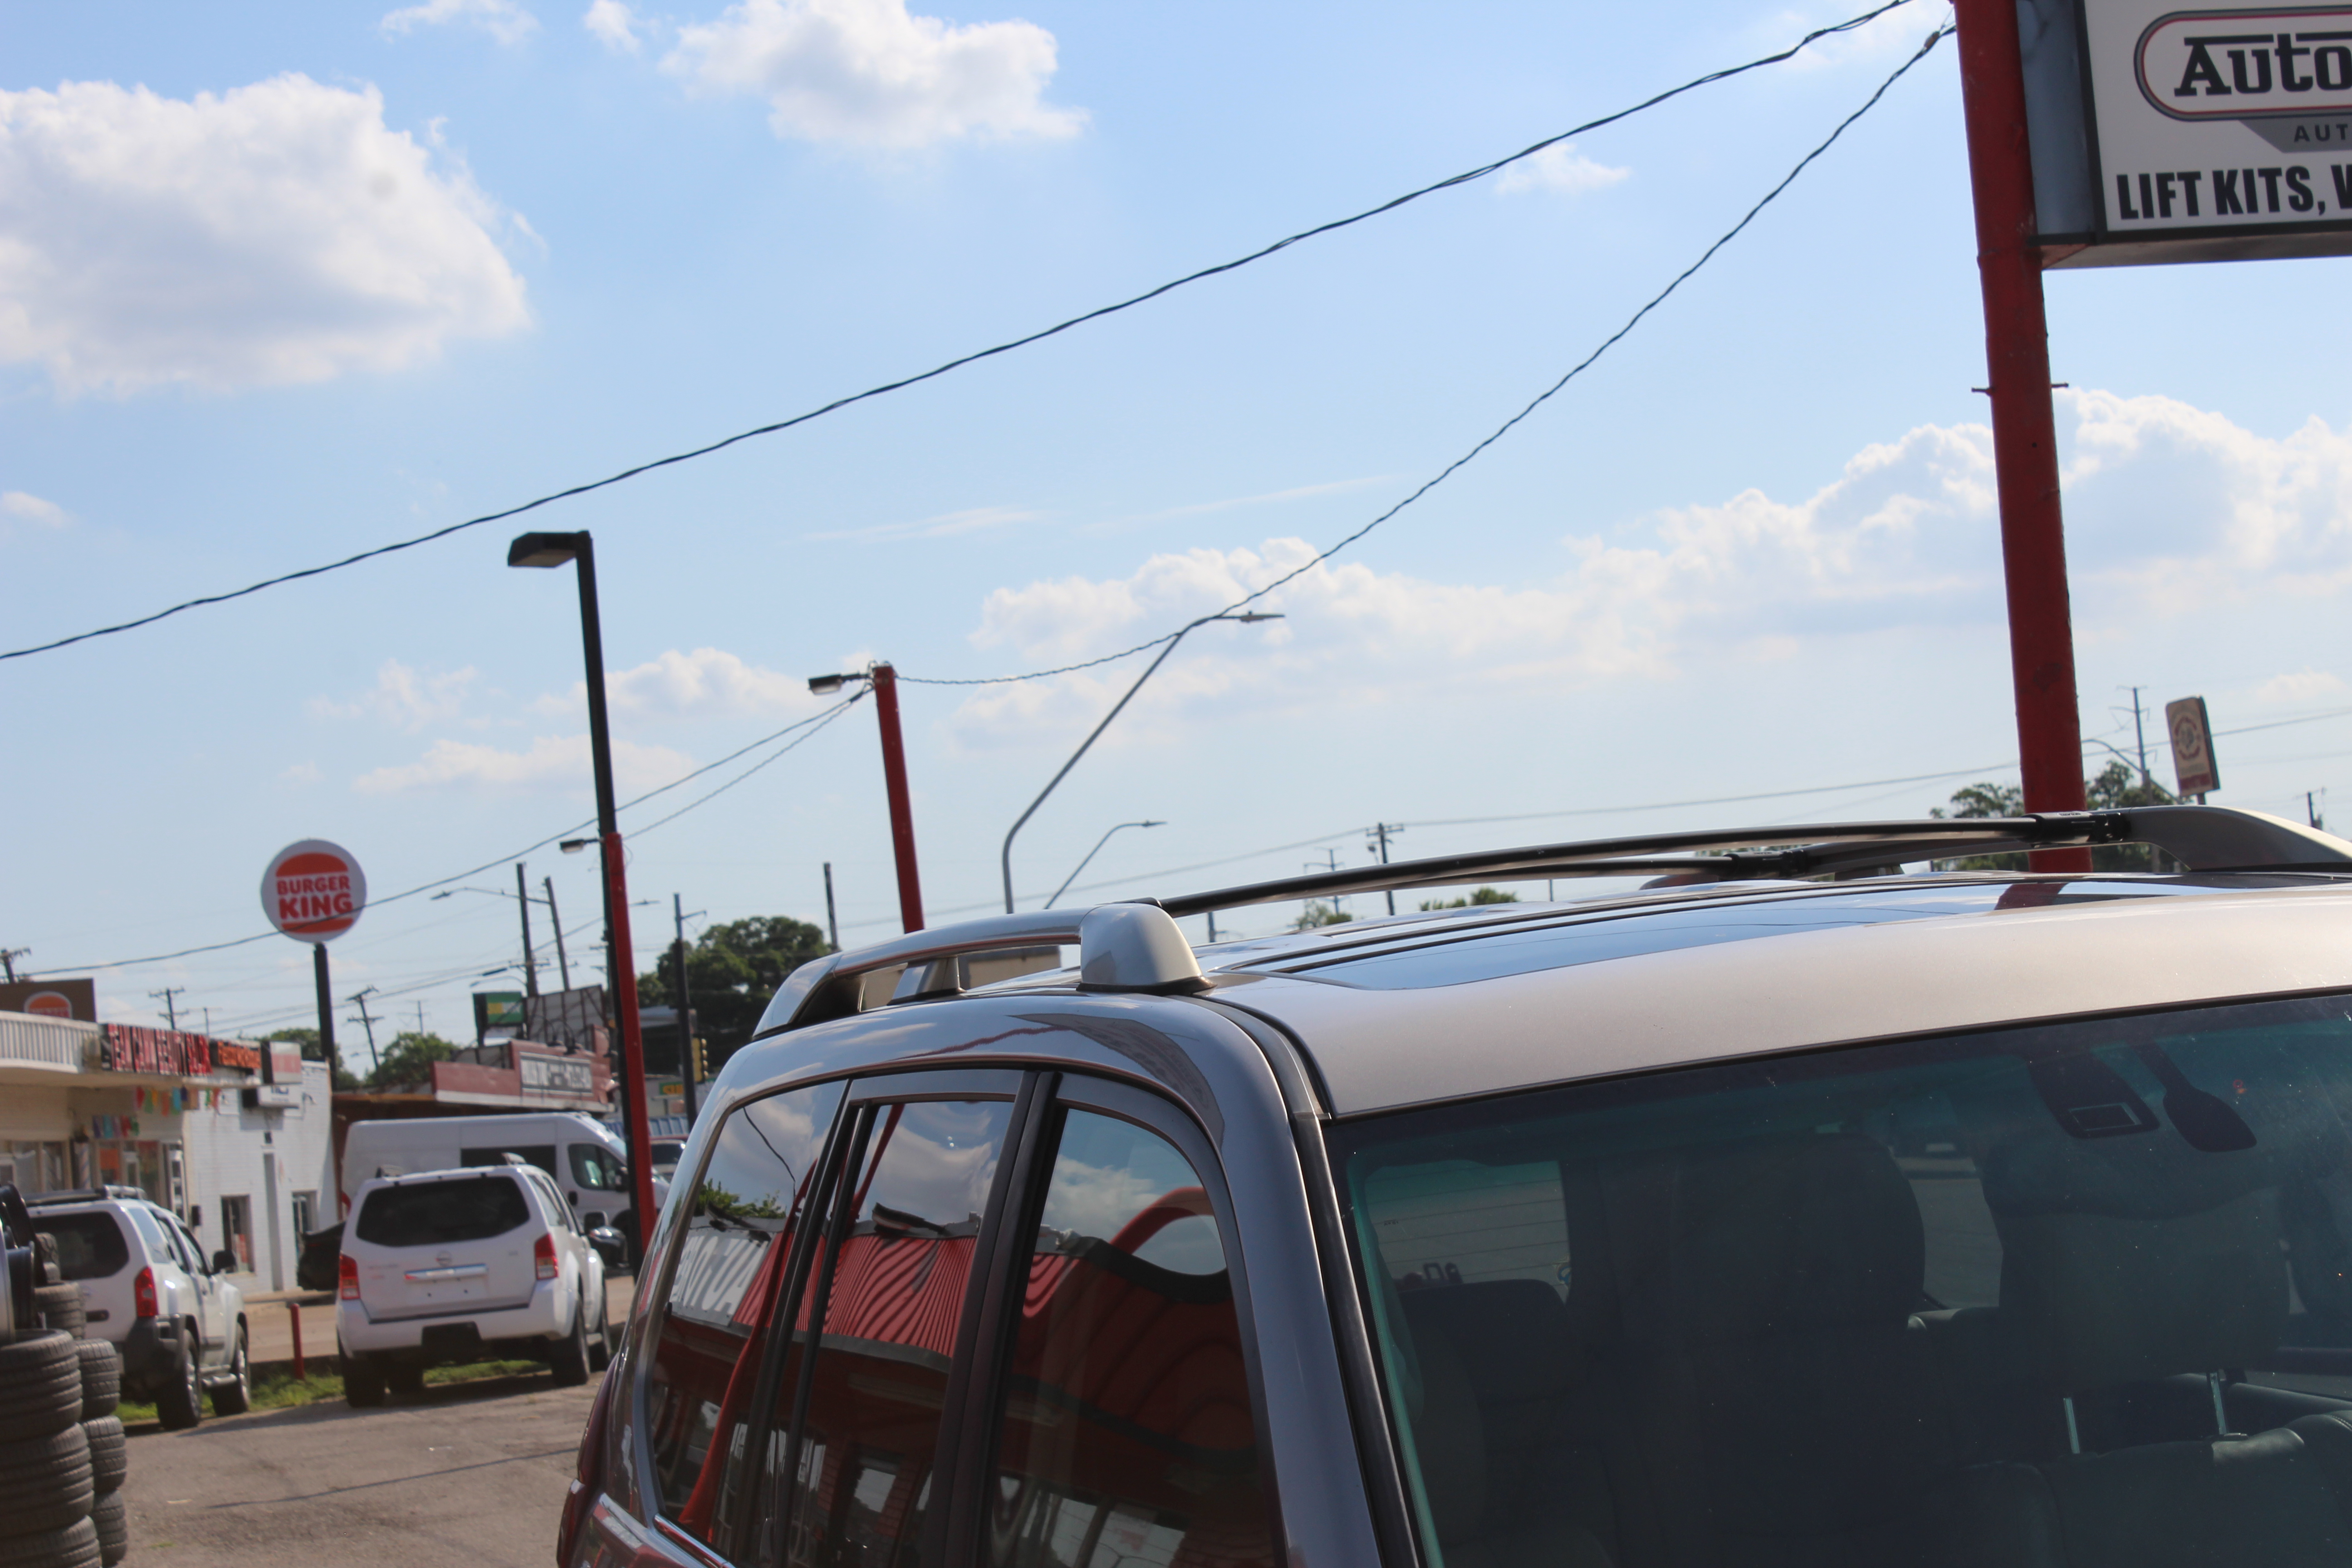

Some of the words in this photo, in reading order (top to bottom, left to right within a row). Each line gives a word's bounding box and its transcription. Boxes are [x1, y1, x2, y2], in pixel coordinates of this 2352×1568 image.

[2293, 123, 2348, 142] AUT
[2116, 171, 2202, 220] LIFT
[2212, 165, 2326, 216] KITS,
[276, 875, 351, 896] BURGER
[279, 892, 353, 920] KING
